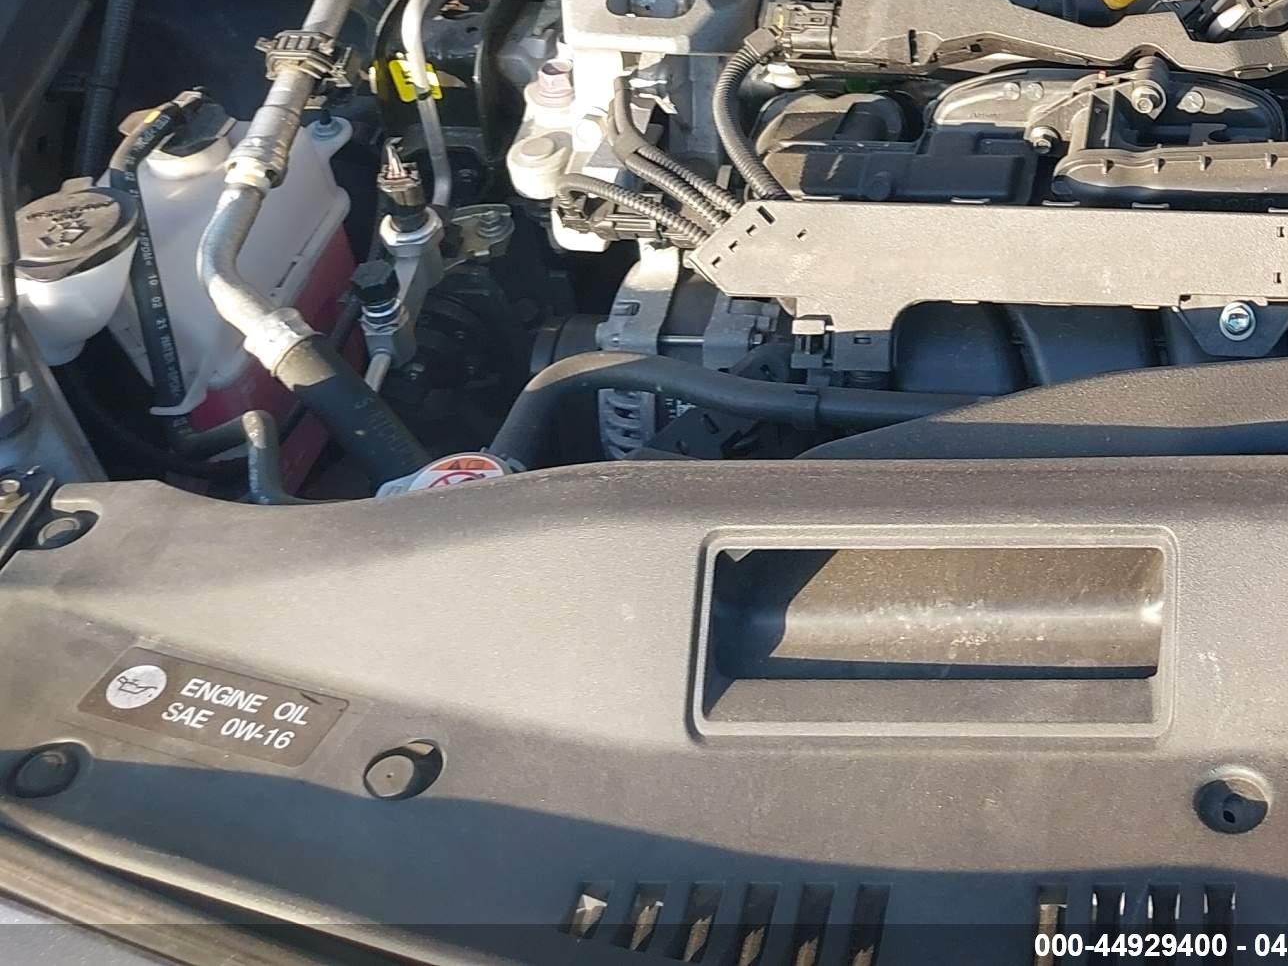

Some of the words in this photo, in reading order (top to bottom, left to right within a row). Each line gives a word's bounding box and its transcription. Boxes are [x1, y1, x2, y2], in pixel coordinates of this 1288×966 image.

[180, 678, 268, 713] ENGINE
[273, 702, 310, 725] OIL
[161, 702, 215, 729] SAE
[220, 718, 296, 749] 0W-16
